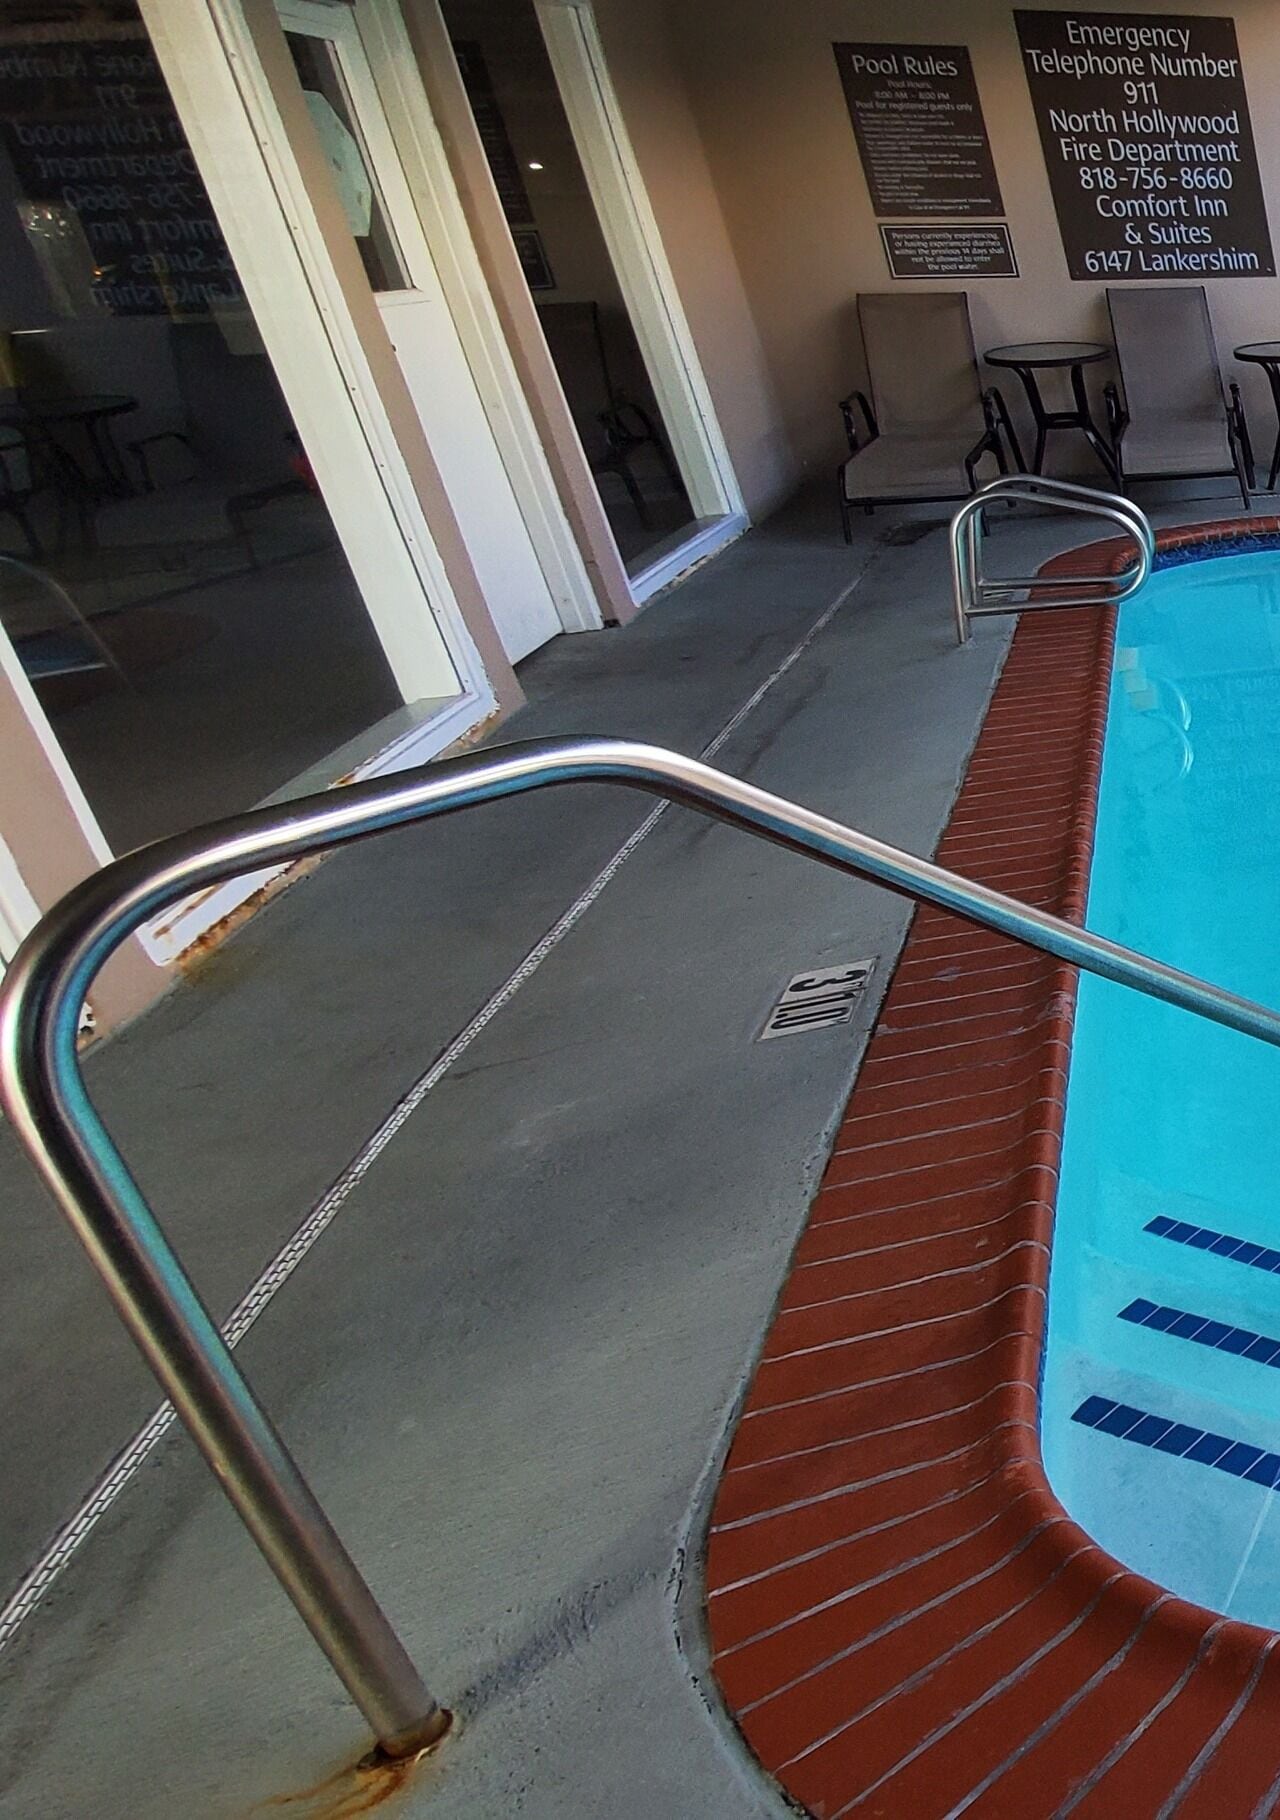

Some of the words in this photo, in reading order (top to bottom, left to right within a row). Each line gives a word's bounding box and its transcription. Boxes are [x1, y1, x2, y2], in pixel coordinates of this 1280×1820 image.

[1065, 20, 1190, 53] Emergency
[851, 54, 899, 75] Pool
[903, 55, 958, 76] Rules
[1026, 48, 1145, 80] Telephone
[1150, 51, 1238, 78] Number
[1123, 80, 1158, 105] 911
[1049, 108, 1116, 133] North
[1122, 109, 1240, 139] Hollywood
[1060, 136, 1102, 162] Fire
[1107, 138, 1241, 167] Department
[1096, 193, 1190, 218] Comfort
[1195, 195, 1229, 217] Inn
[1125, 222, 1144, 245] &
[1148, 220, 1212, 244] Suites
[1085, 249, 1131, 272] 6147
[1140, 247, 1259, 271] Lankershim
[789, 969, 867, 993] 3
